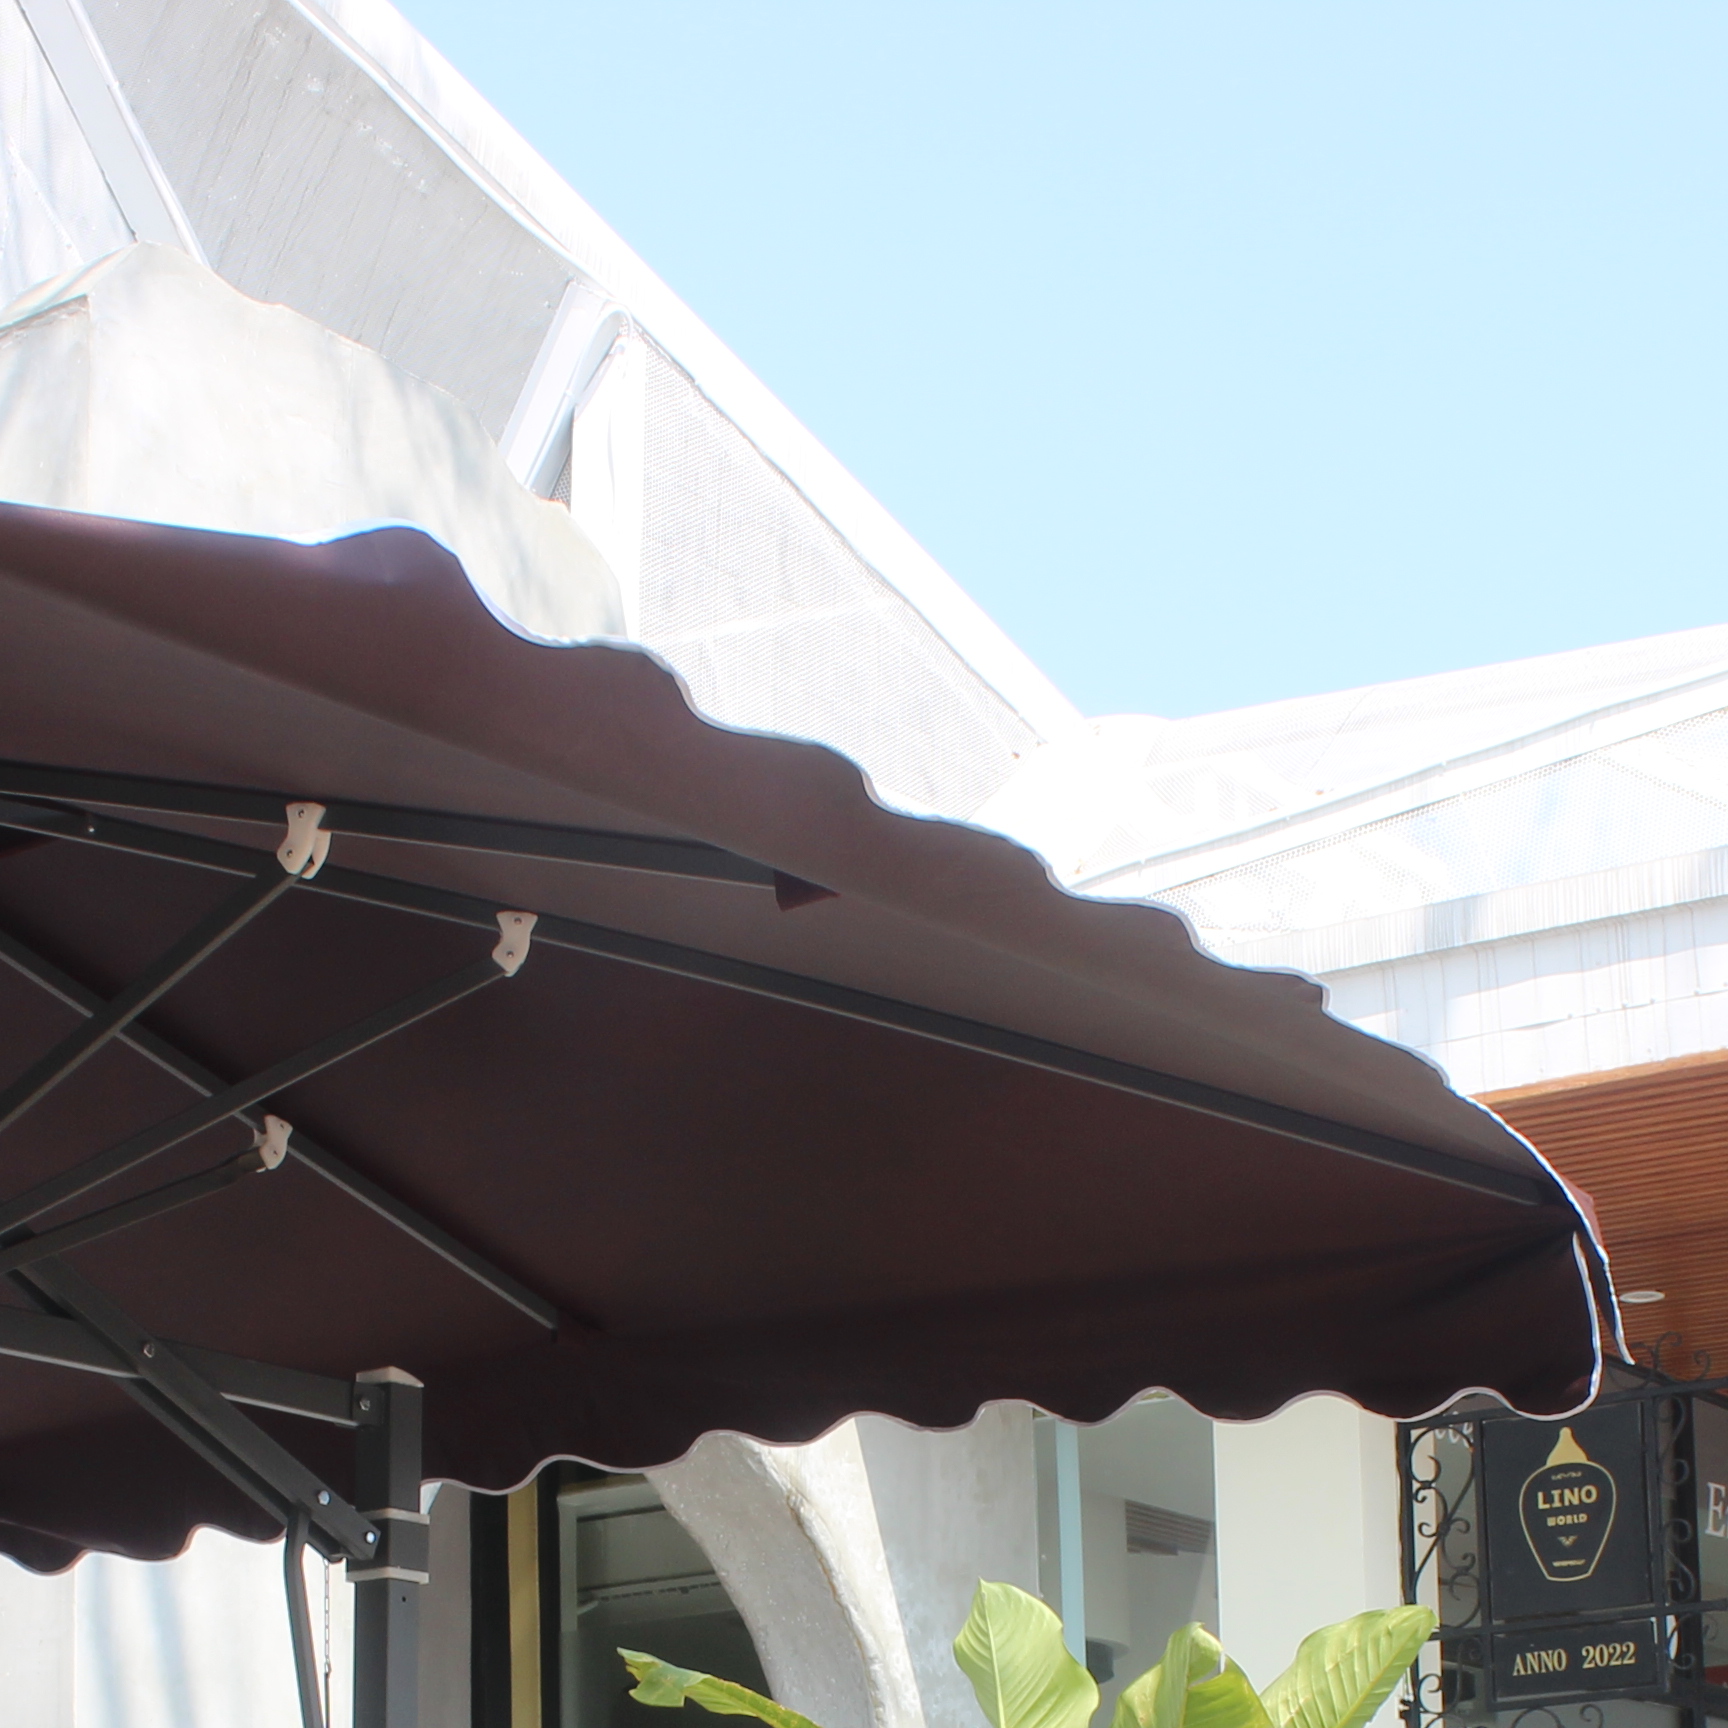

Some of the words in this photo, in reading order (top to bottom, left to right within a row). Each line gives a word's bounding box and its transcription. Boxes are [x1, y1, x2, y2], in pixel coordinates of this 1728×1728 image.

[1537, 1484, 1598, 1510] LINO
[1546, 1512, 1588, 1527] WORLD
[1512, 1648, 1568, 1676] ANNO
[1581, 1641, 1636, 1669] 2022
